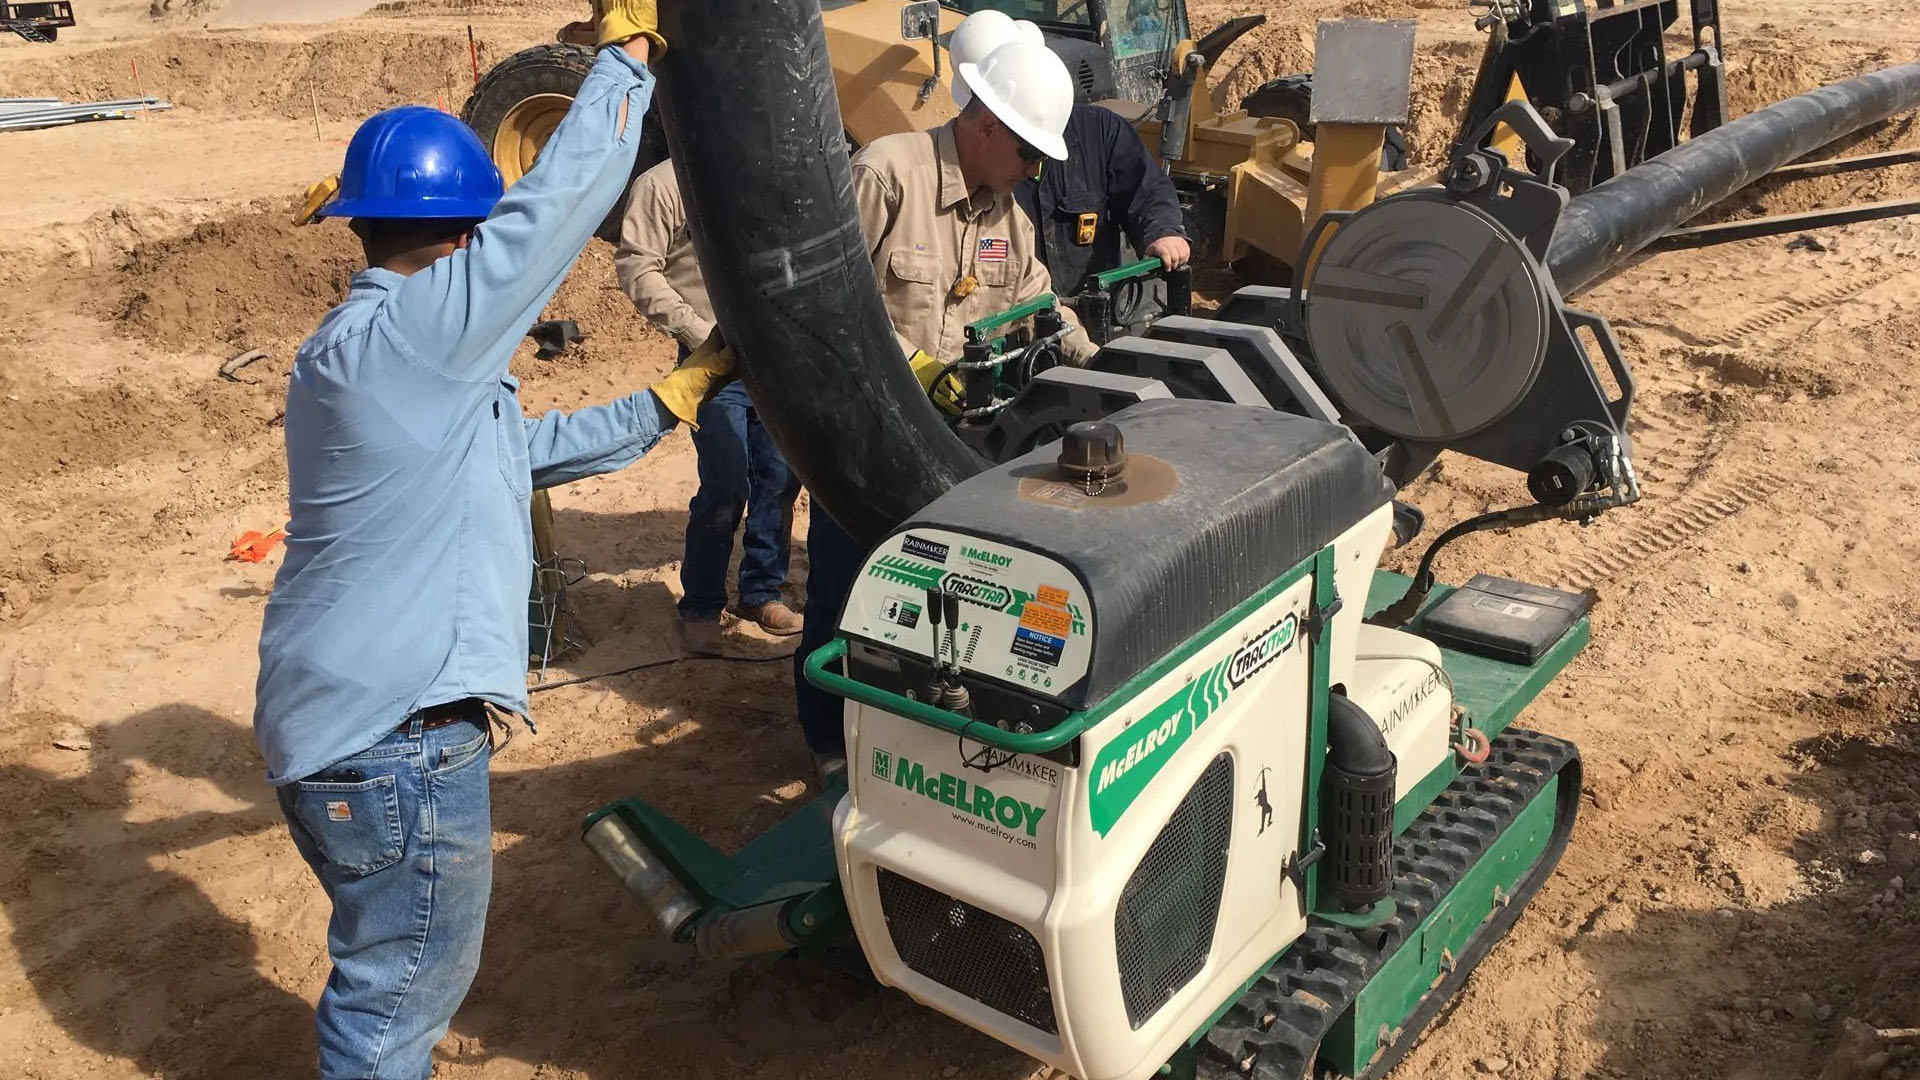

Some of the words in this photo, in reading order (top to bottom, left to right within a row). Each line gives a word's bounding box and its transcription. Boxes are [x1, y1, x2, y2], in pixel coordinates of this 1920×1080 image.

[967, 547, 1013, 568] McELROY
[948, 579, 1005, 604] TRACSTAR
[1029, 631, 1053, 644] NOTICE
[1235, 622, 1293, 678] TRACSTAR
[1096, 708, 1185, 795] McELROY
[895, 756, 1046, 837] McELROY
[952, 812, 1037, 851] www.mcelroy.com
